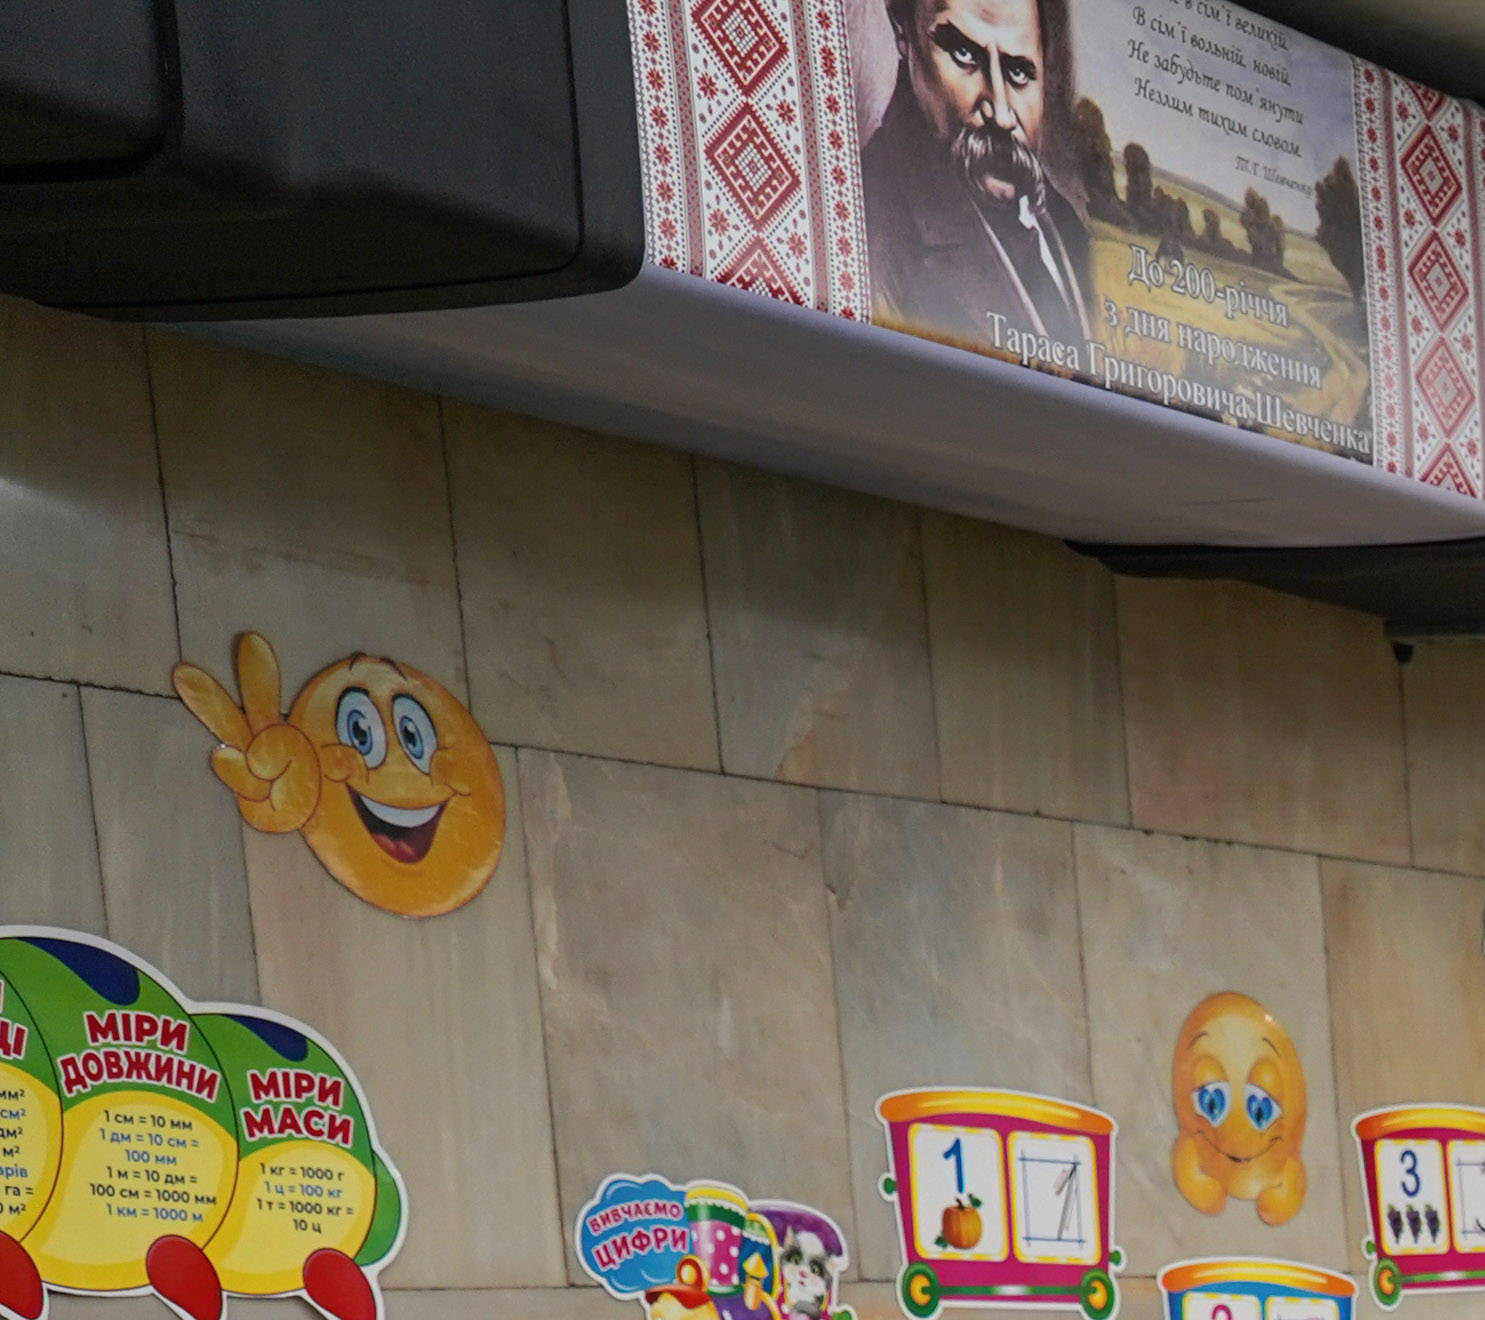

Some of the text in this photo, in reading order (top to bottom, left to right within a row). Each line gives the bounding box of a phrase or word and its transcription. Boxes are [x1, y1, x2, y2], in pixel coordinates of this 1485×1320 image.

[1132, 6, 1146, 26] В
[1128, 39, 1150, 63] Не
[1154, 53, 1221, 92] забудьте
[1134, 77, 1194, 118] Незлим
[1198, 107, 1248, 138] тихим
[1128, 244, 1290, 328] До 200-річчя
[1105, 300, 1322, 390] з дня народження
[986, 311, 1372, 455] Тараса Григоровича Шевченка
[86, 1012, 188, 1052] МІРИ
[60, 1050, 220, 1100] ДОВЖИНИ
[249, 1071, 343, 1106] МІРИ
[114, 1114, 134, 1124] см
[150, 1114, 166, 1128] 10
[170, 1119, 193, 1131] мм
[243, 1109, 352, 1145] МАСИ
[110, 1132, 131, 1144] дм
[148, 1133, 163, 1146] 10
[167, 1138, 187, 1149] см
[124, 1150, 177, 1166] 100 мм
[270, 1168, 285, 1179] кг
[301, 1167, 333, 1181] 1000
[943, 1138, 964, 1196] 1
[1401, 1150, 1421, 1198] 3
[90, 1183, 115, 1197] 100
[120, 1188, 139, 1199] см
[155, 1190, 190, 1204] 1000
[194, 1194, 216, 1205] мм
[118, 1169, 128, 1180] м
[145, 1169, 160, 1183] 10
[165, 1174, 185, 1186] дм
[275, 1184, 285, 1196] ц
[299, 1184, 324, 1197] 100
[329, 1188, 343, 1199] кг
[117, 1206, 137, 1218] км
[154, 1208, 189, 1222] 1000
[192, 1212, 204, 1222] м
[291, 1200, 322, 1215] 1000
[327, 1205, 342, 1217] кг
[588, 1202, 682, 1234] ВИВЧАЄМО
[292, 1219, 322, 1235] 10 ц
[593, 1228, 688, 1269] ЦИФРИ
